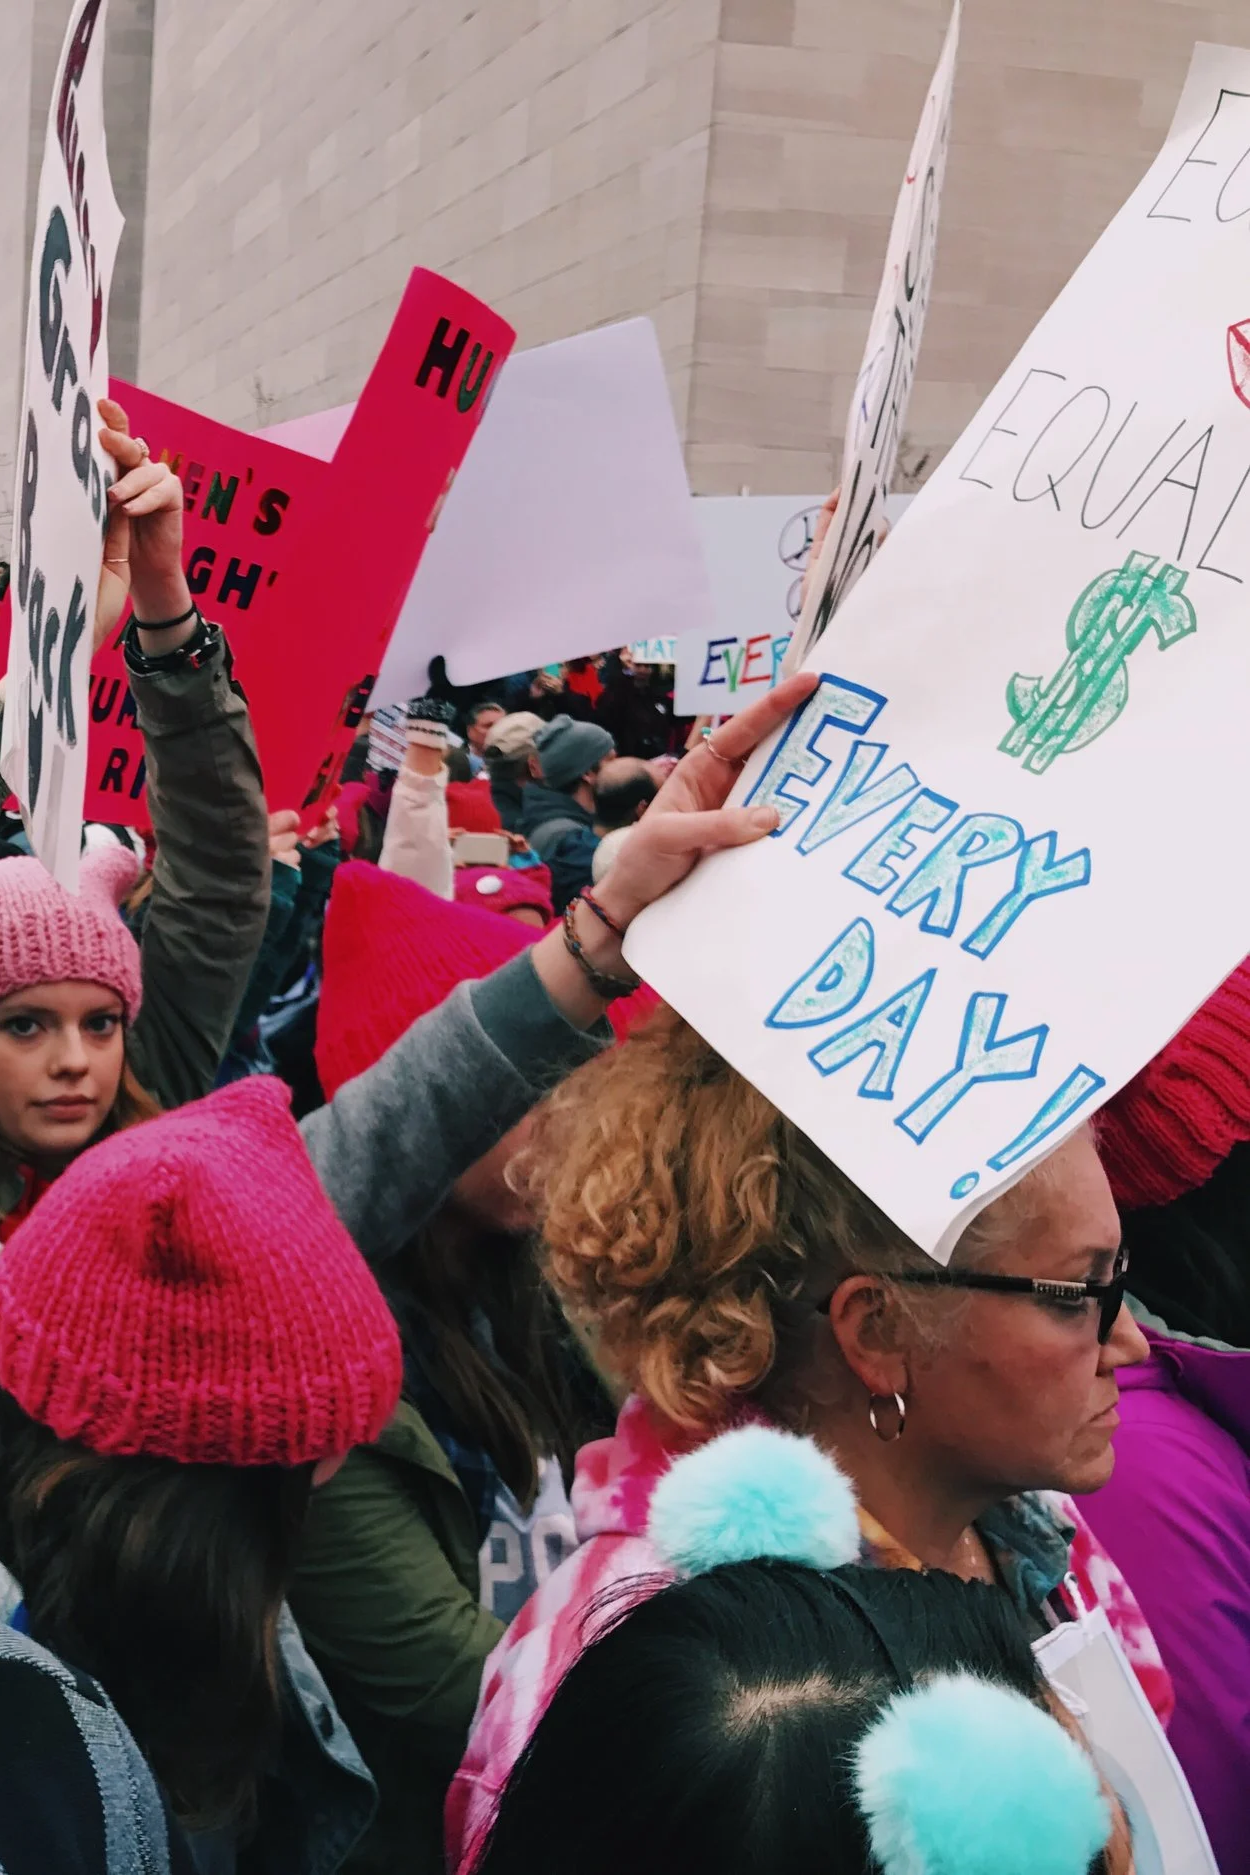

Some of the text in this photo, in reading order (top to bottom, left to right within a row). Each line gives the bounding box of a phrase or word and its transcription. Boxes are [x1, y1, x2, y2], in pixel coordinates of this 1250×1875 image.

[415, 316, 500, 419] HU
[959, 368, 1250, 583] EQUAL
[698, 632, 794, 693] EVER
[745, 673, 1092, 961] EVERY
[764, 917, 1106, 1200] DAY!
